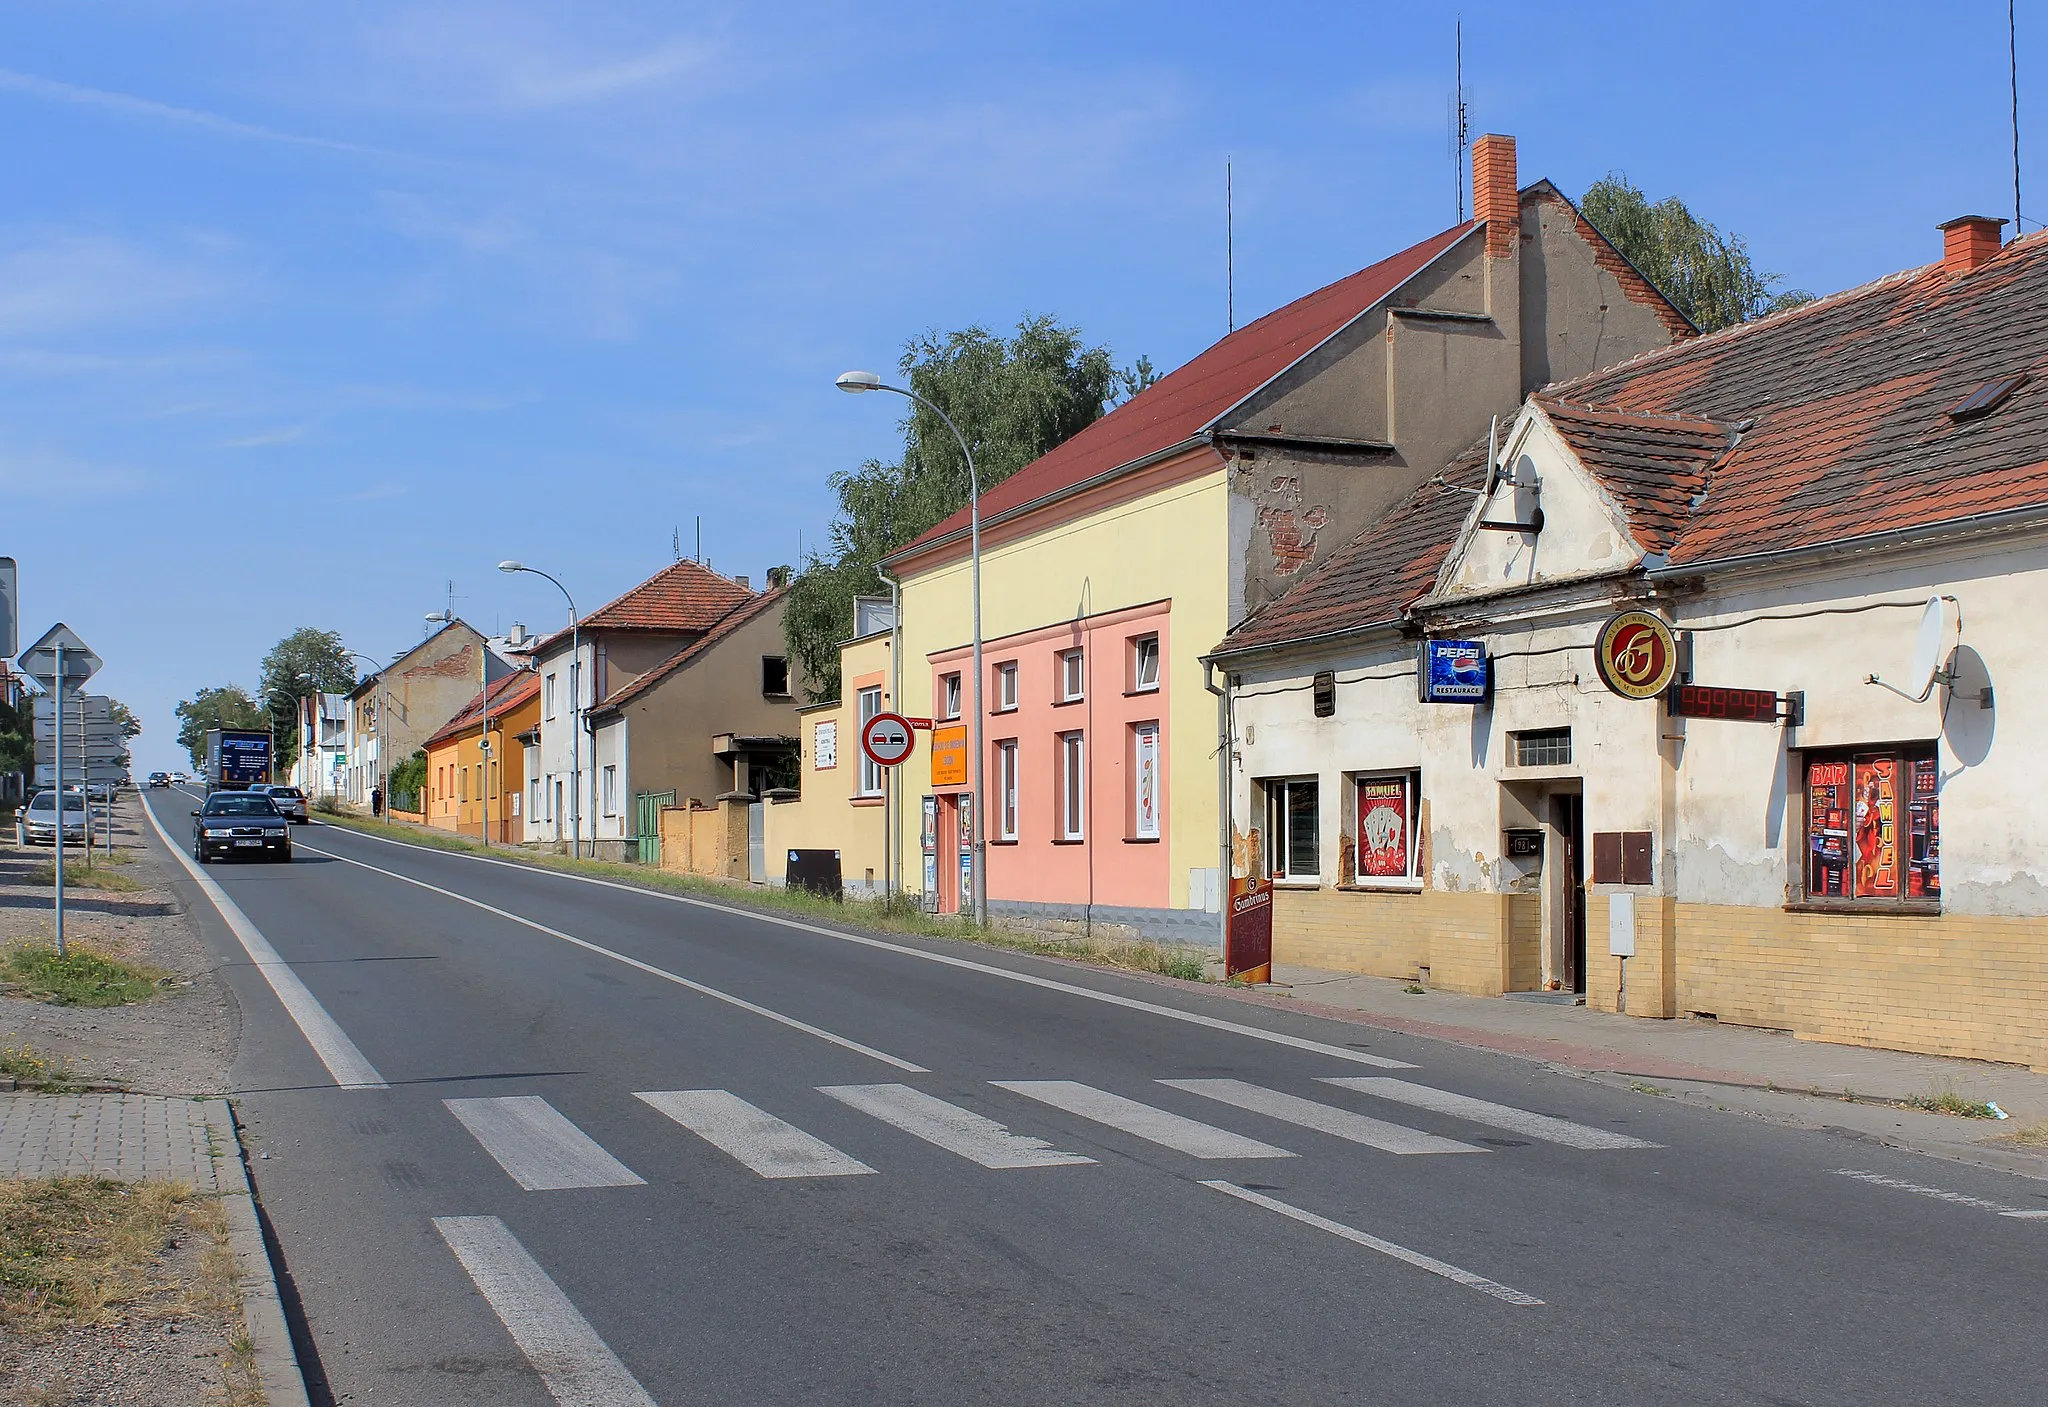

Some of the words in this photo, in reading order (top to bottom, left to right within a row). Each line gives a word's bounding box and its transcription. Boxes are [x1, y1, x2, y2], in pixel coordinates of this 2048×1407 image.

[1631, 615, 1654, 625] ROKU
[1436, 647, 1479, 658] PEPSI
[1611, 673, 1666, 694] GAMBRINUS
[1811, 762, 1847, 786] BAR
[1365, 783, 1402, 799] SAMUEL
[1873, 758, 1895, 889] SAMUEL
[1234, 891, 1270, 912] Gambrinus
